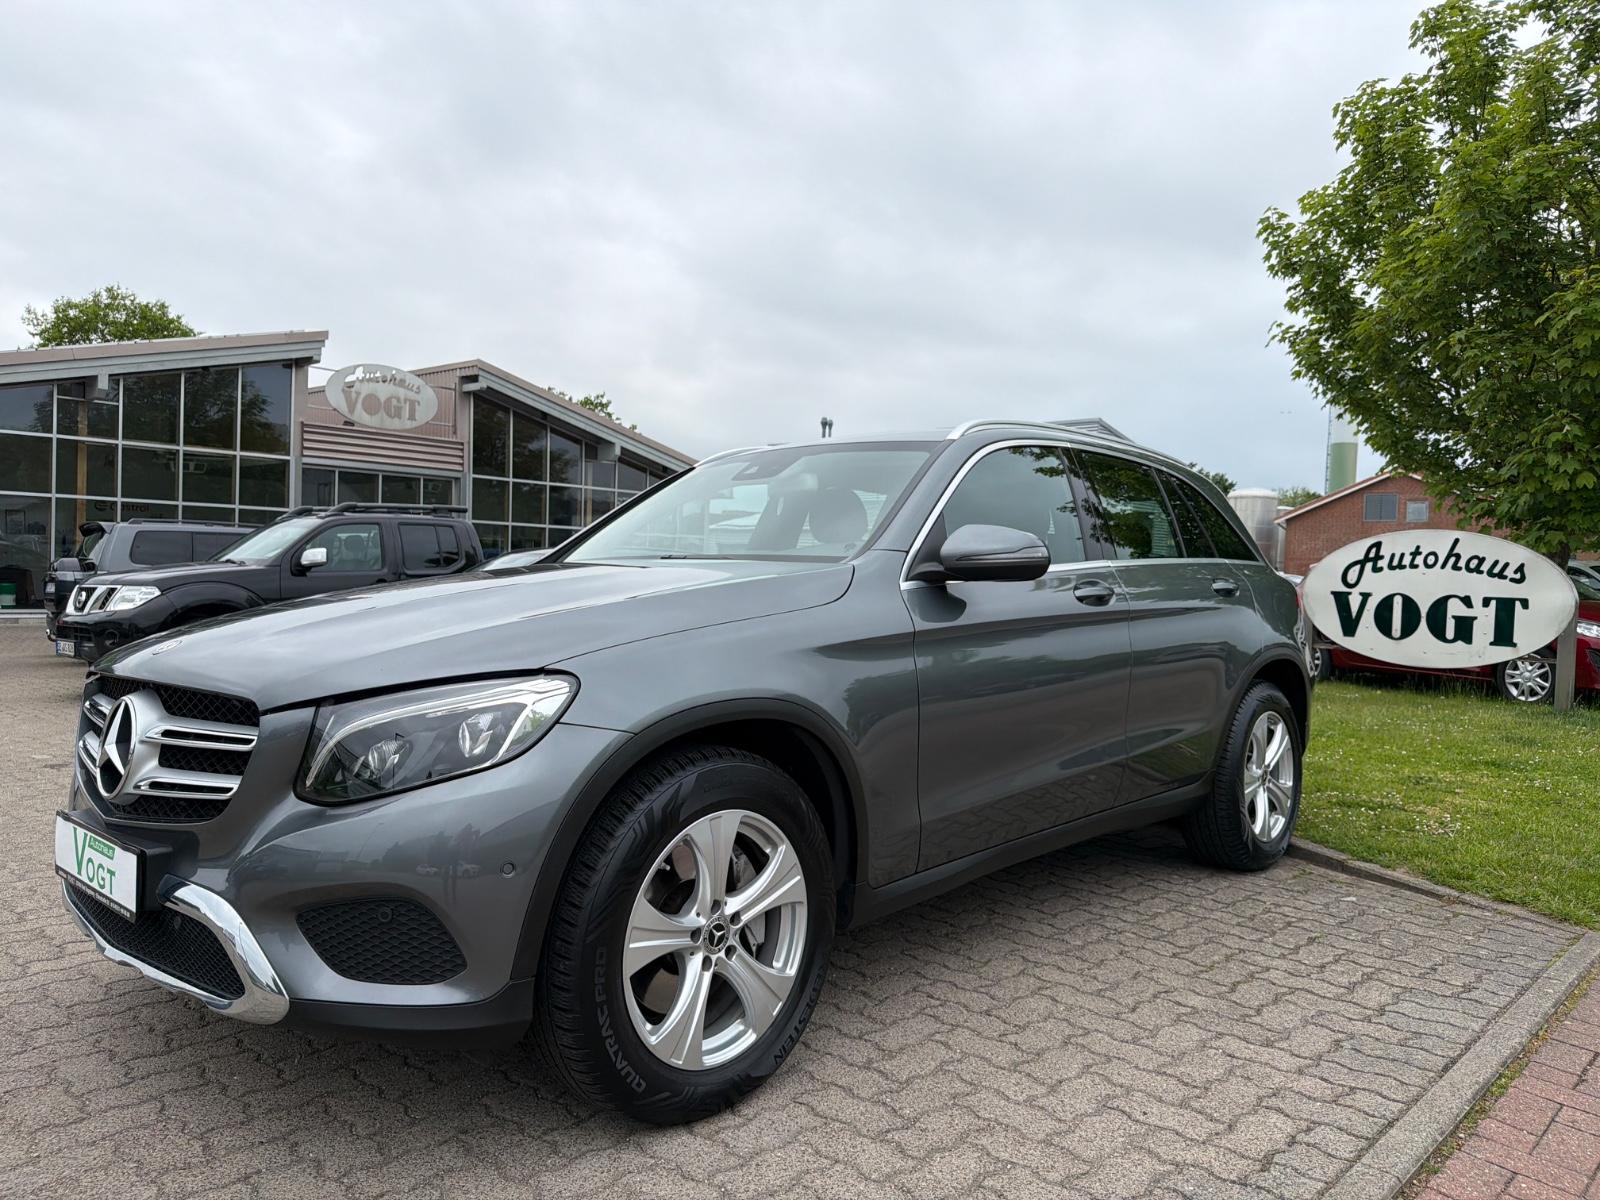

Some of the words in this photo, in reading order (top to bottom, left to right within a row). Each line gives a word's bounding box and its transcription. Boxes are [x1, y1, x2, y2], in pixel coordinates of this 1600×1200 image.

[342, 386, 421, 421] VOGT
[110, 501, 150, 512] Cstrol
[1341, 537, 1527, 589] Autohaus
[1330, 590, 1530, 648] VOGT
[597, 1004, 647, 1094] QUATRAC
